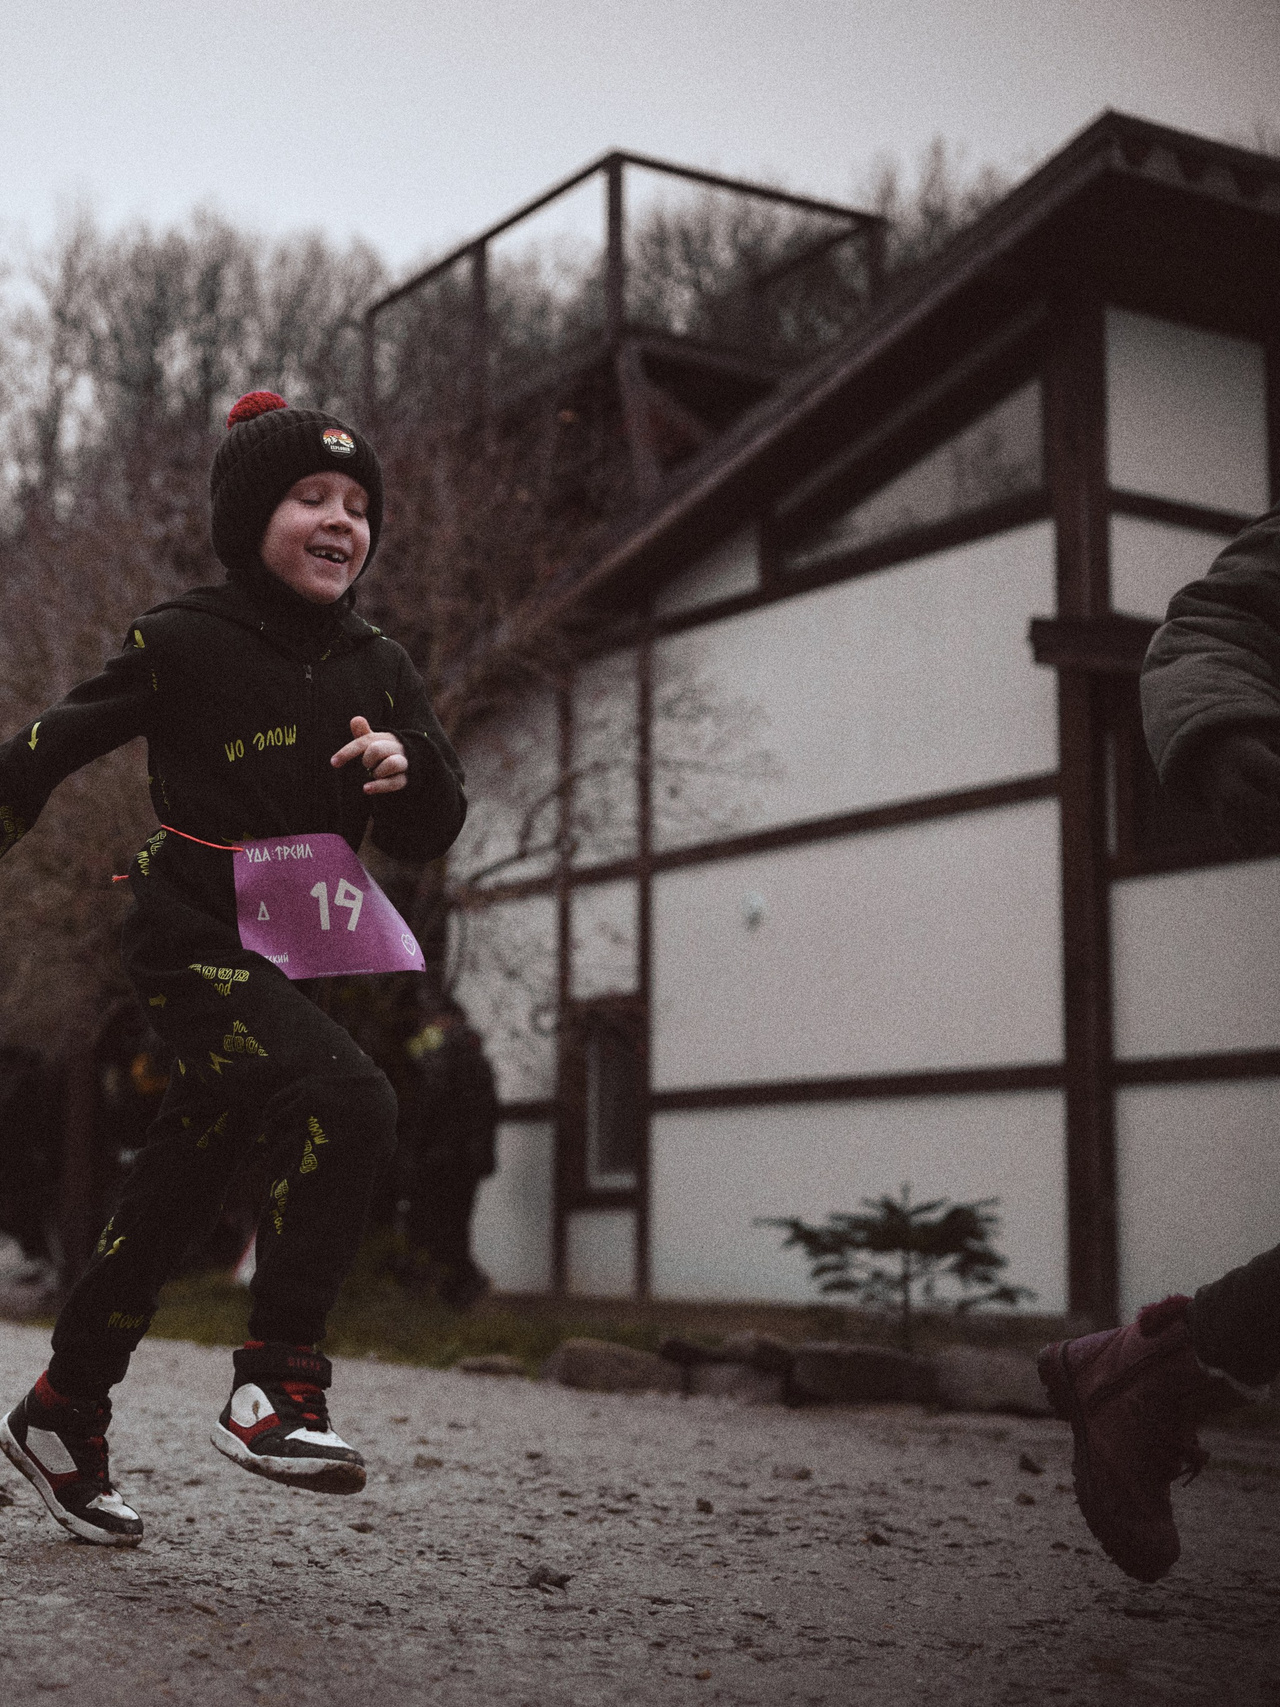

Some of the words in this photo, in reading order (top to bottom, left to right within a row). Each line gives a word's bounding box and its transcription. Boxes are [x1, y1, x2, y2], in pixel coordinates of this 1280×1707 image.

[224, 739, 245, 762] on
[253, 724, 297, 751] move
[310, 877, 364, 932] 19
